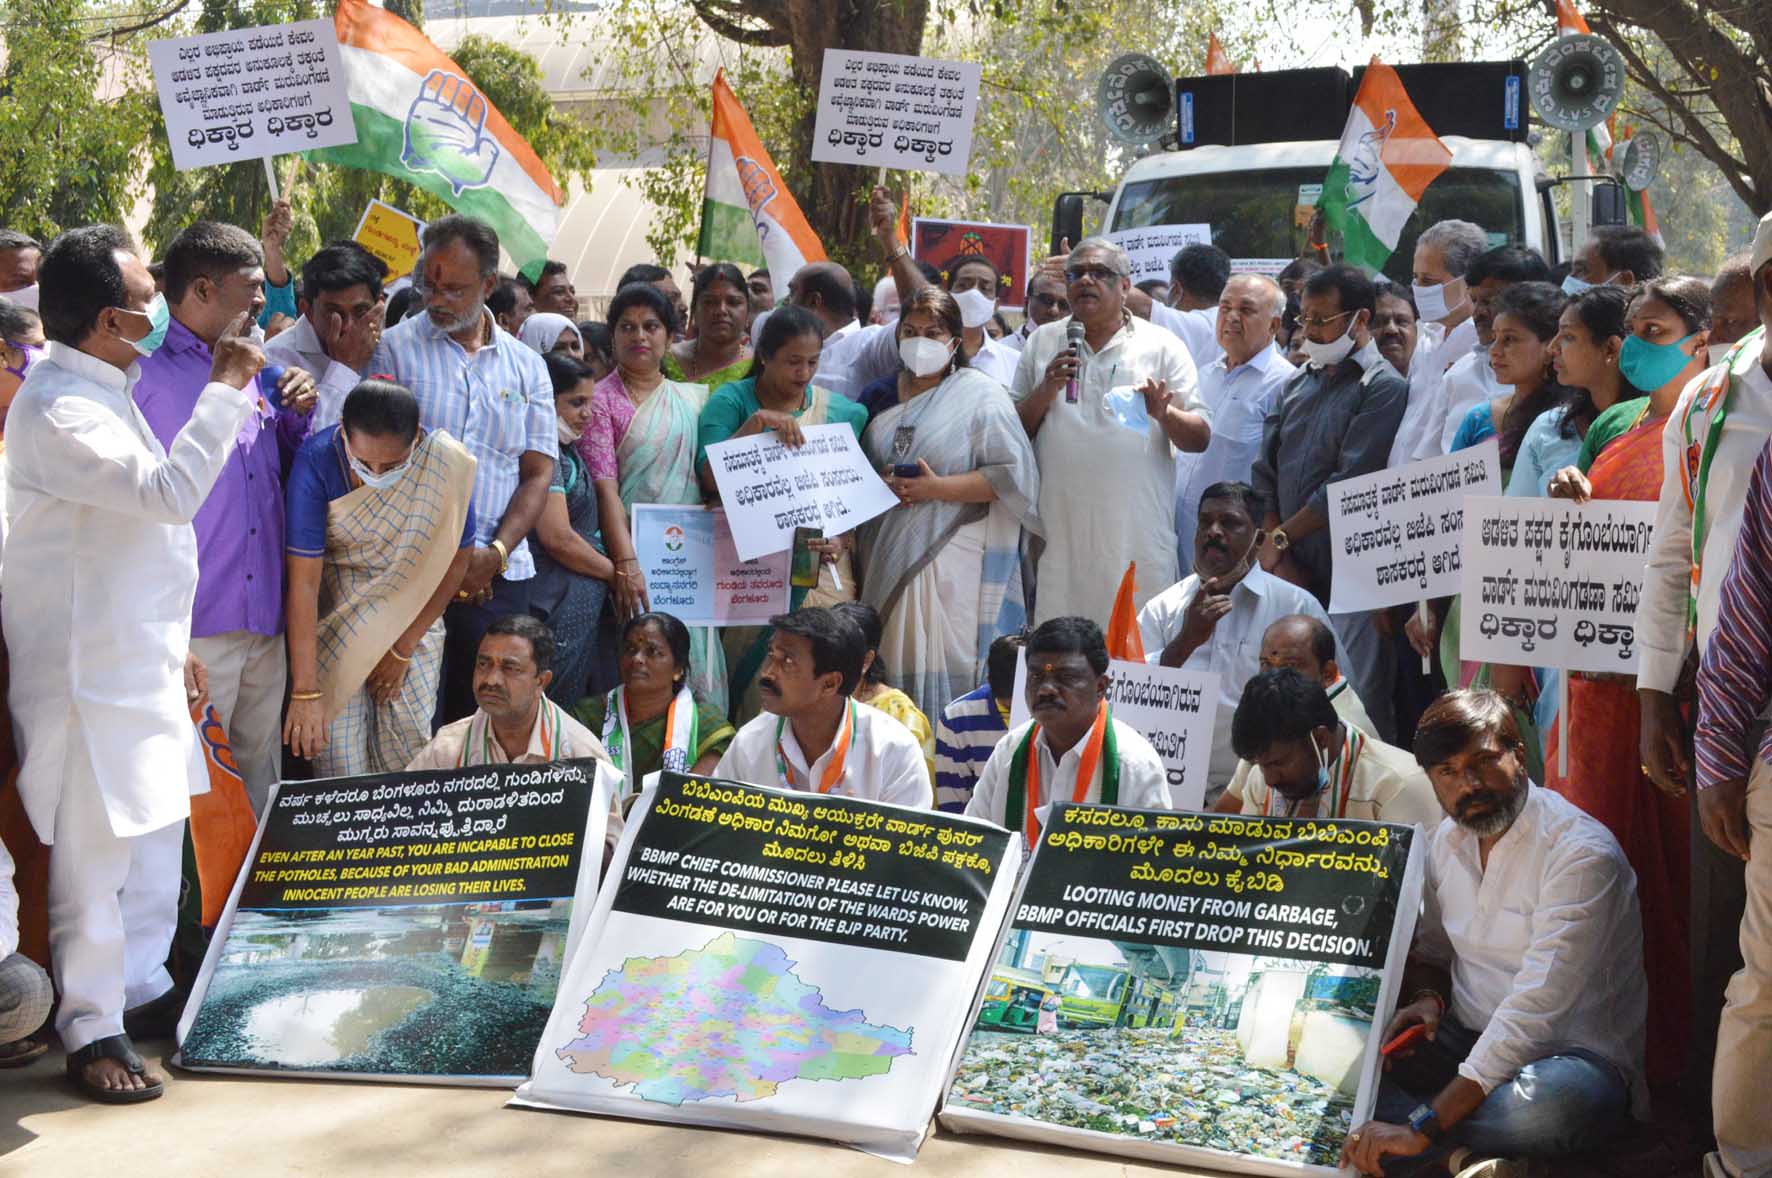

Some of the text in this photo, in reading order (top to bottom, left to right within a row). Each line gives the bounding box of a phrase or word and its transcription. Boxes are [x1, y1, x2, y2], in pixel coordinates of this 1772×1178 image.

[288, 30, 315, 45] ಕೇವಲ
[242, 77, 270, 93] ವಾರ್ಡ್
[188, 107, 334, 150] ಧಿಕ್ಕಾರ ಧಿಕ್ಕಾರ
[203, 103, 253, 121] ಮಾಡುತ್ತಿರುವ
[1558, 107, 1592, 121] LVS
[828, 128, 953, 162] ಧಿಕ್ಕಾರ ಧಿಕ್ಕಾರ
[1381, 478, 1406, 505] ವಾರ್ಡ್
[1345, 512, 1435, 556] ಅಧಿಕಾರವೆಲ್ಲ ಬಿಜೆಪಿ
[1524, 512, 1554, 566] ಪಕ್ಷದ
[1482, 568, 1519, 605] ವಾರ್ಡ್
[1480, 613, 1558, 652] ಧಿಕ್ಕಾರ
[279, 765, 588, 807] ವರ್ಷ ಕಳೆದರೂ ಬೆಂಗಳೂರು ನಗರದಲ್ಲಿ ಗುಂಡಿಗಳನ್ನು
[292, 810, 351, 826] ಮುಚ್ಚಲು
[353, 804, 415, 823] ಸಾಧ್ಯವಿಲ್ಲ
[457, 788, 564, 813] ದುರಾಡಳಿತದಿಂದ
[682, 779, 985, 847] ಬಿಬಿಎಂಪಿಯ ಮುಖ್ಯ ಆಯುಕ್ತರೇ ವಾರ್ಡ್ ಪುನರ್
[655, 798, 717, 824] ವಿಂಗಡಣೆ
[718, 811, 775, 833] ಅಧಿಕಾರ
[775, 820, 838, 844] ನಿಮಗೋ
[843, 833, 892, 852] ಅಥವಾ
[898, 839, 940, 861] ಬಿಜೆಪಿ
[1064, 807, 1391, 848] ಕಸದಲ್ಲೂ ಕಾಸು ಮಾಡುವ ಬಿಬಿಎಂಪಿ
[260, 833, 574, 863] EVEN AFTER AN YEAR PAST, YOU ARE INCAPABLE TO CLOSE
[762, 841, 866, 871] ಮೊದಲು ತಿಳಿಸಿ
[1047, 830, 1389, 879] ಅಧಿಕಾರಿಗಳೇ ಈ ನಿಮ್ಮ ನಿರ್ಧಾರವನ್ನು
[255, 855, 569, 882] THE POTHOLES, BECAUSE OF YOUR BAD ADMINISTRATION
[641, 848, 969, 914] BBMP CHIEF COMMISSIONER PLEASE LET US KNOW,
[1129, 861, 1285, 894] ಮೊದಲು ಕೈಬಿಡಿ
[282, 878, 526, 901] INNOCENT PEOPLE ARE LOSING THEIR LIVES.
[627, 866, 970, 932] WHETHER THE DE-LIMITATION OF THE WARDS POWER
[1063, 885, 1338, 930] LOOTING MONEY FROM GARBAGE,
[667, 895, 909, 942] ARE FOR YOU OR FOR THE BJP PARTY.
[1016, 905, 1374, 958] BBMP OFFICIALS FIRST DROP THIS DECISION.
